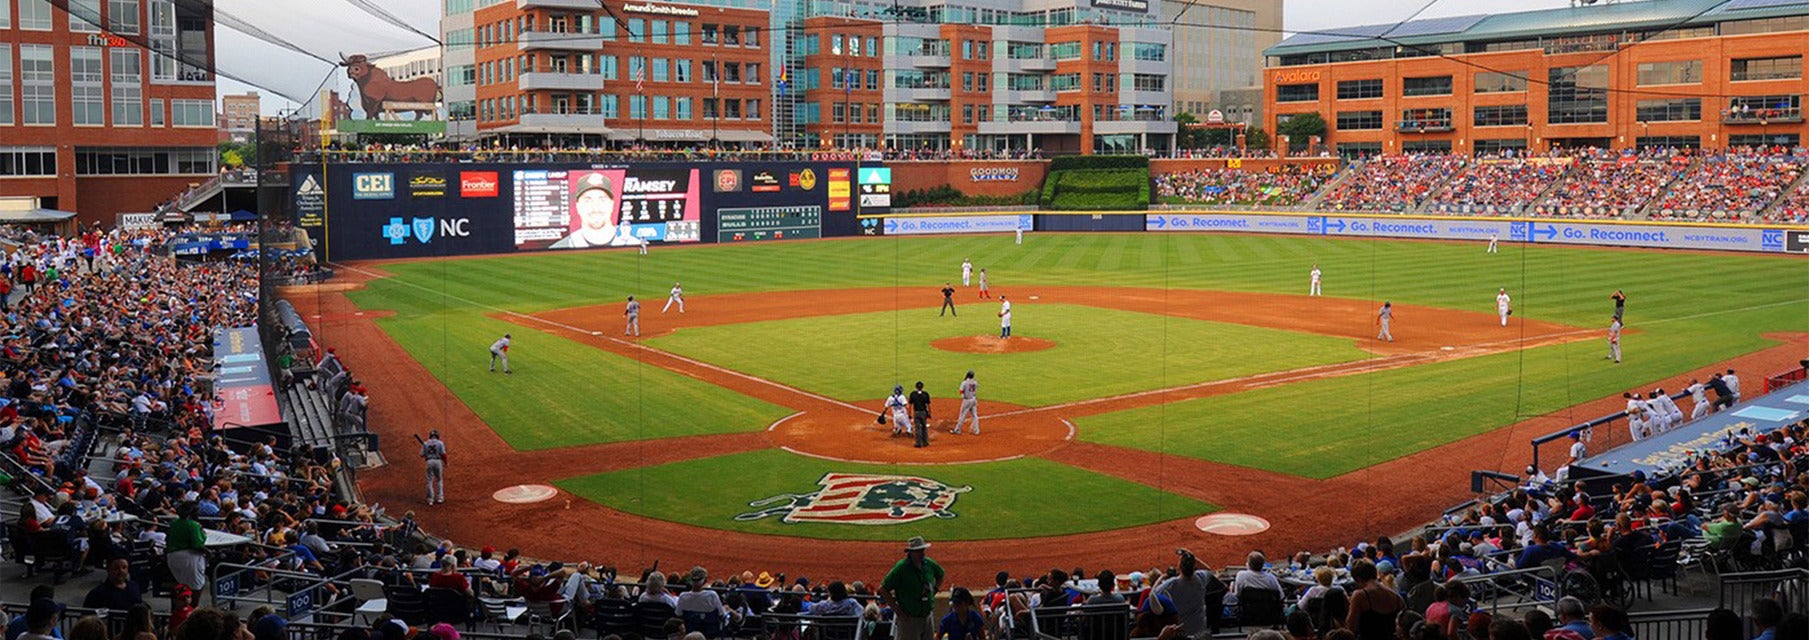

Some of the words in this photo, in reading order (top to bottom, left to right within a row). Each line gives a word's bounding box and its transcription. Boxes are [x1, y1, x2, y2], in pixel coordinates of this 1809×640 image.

[651, 5, 671, 14] Smith
[1274, 69, 1320, 83] Avalara
[655, 130, 684, 138] Tobacco
[356, 175, 390, 192] CEI
[462, 180, 495, 189] Frontier
[624, 180, 675, 192] RAMSEY
[441, 218, 469, 237] NC
[902, 221, 918, 230] Go.
[920, 220, 972, 230] Reconnect.
[1171, 217, 1189, 226] Go.
[1193, 218, 1249, 228] Reconnect.
[1307, 220, 1320, 228] NC
[1351, 221, 1369, 232] Go.
[1373, 222, 1437, 234] Reconnect.
[1511, 224, 1525, 234] NC
[1563, 227, 1585, 238] Go.
[1590, 228, 1669, 242] Reconnect.
[1684, 234, 1748, 243] NCBYTRAIN.ORG
[1762, 233, 1782, 244] NC
[220, 580, 234, 592] 101
[292, 595, 310, 609] 100
